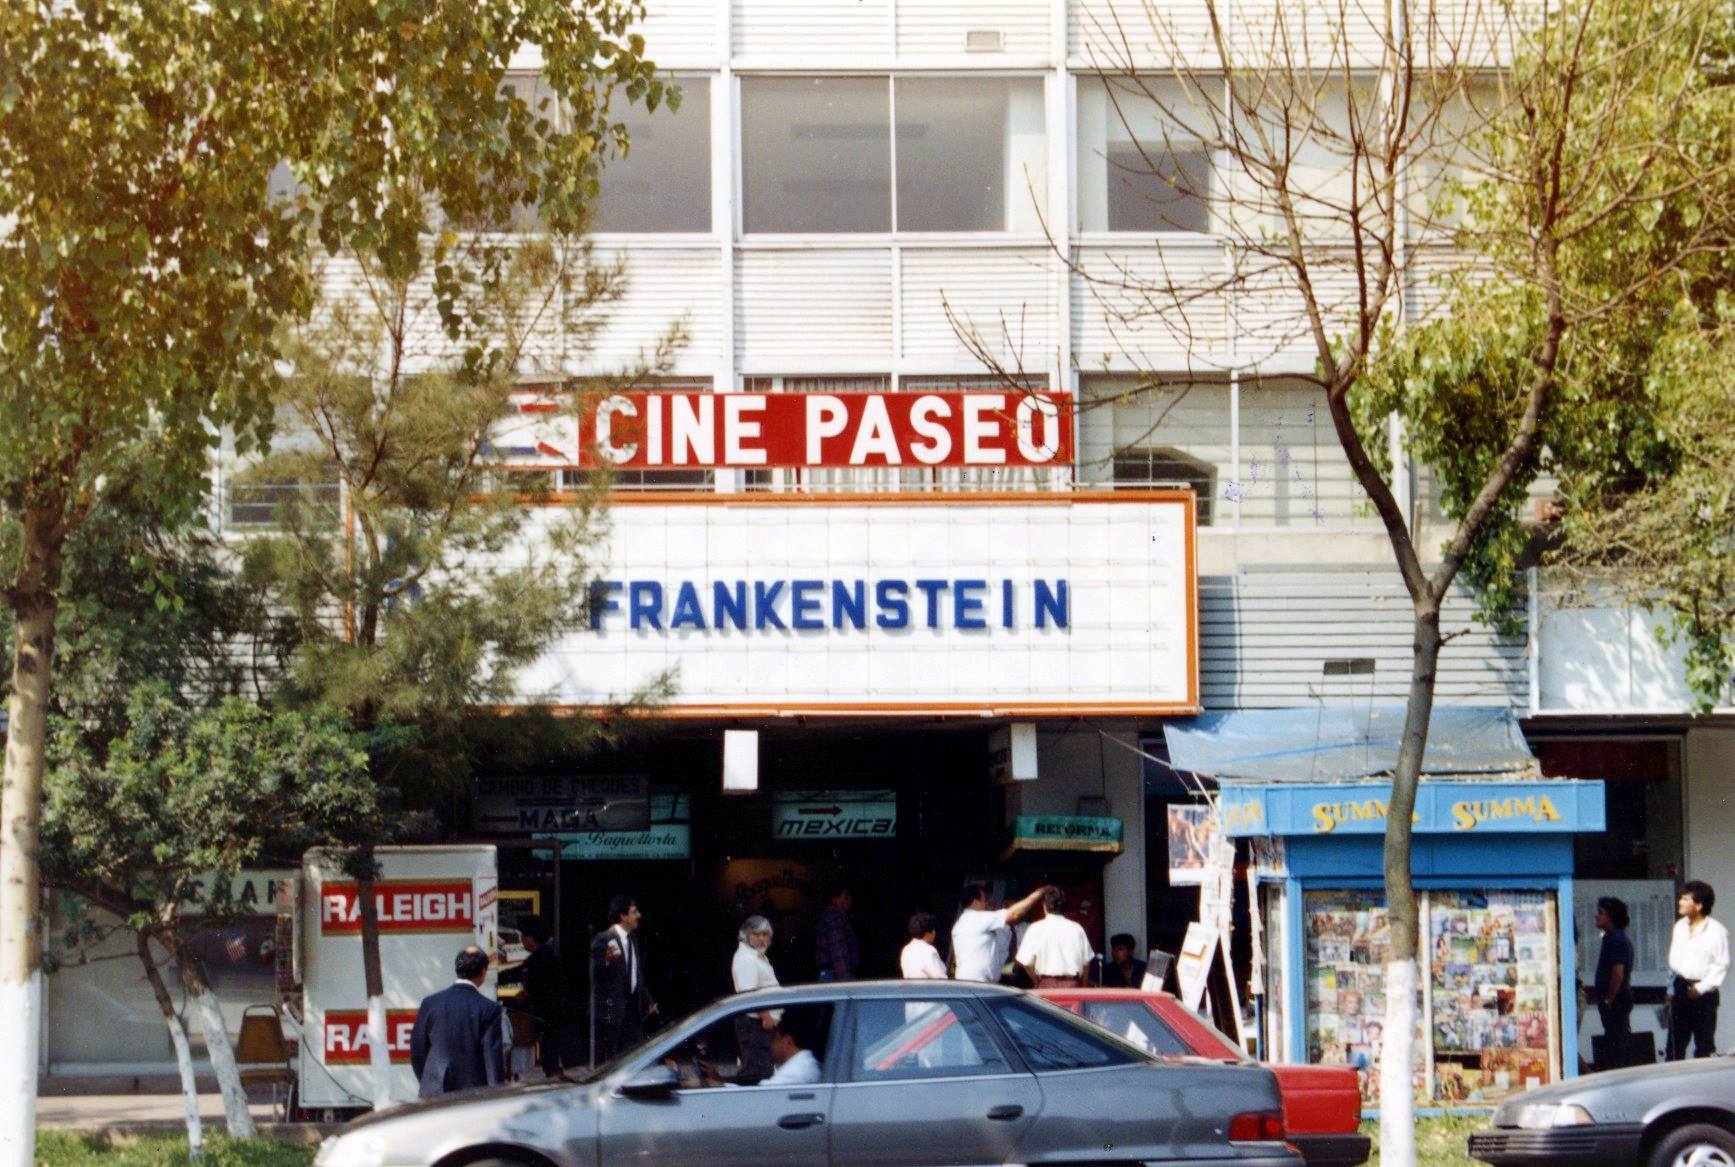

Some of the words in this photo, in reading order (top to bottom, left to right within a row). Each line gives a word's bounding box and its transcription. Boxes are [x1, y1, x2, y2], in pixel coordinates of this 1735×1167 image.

[596, 395, 767, 464] CINE
[806, 394, 1059, 464] PASEO
[590, 579, 1069, 630] FRANKENSTEIN
[542, 778, 562, 795] DE
[777, 818, 896, 834] mexica
[1450, 793, 1563, 831] SUMMA
